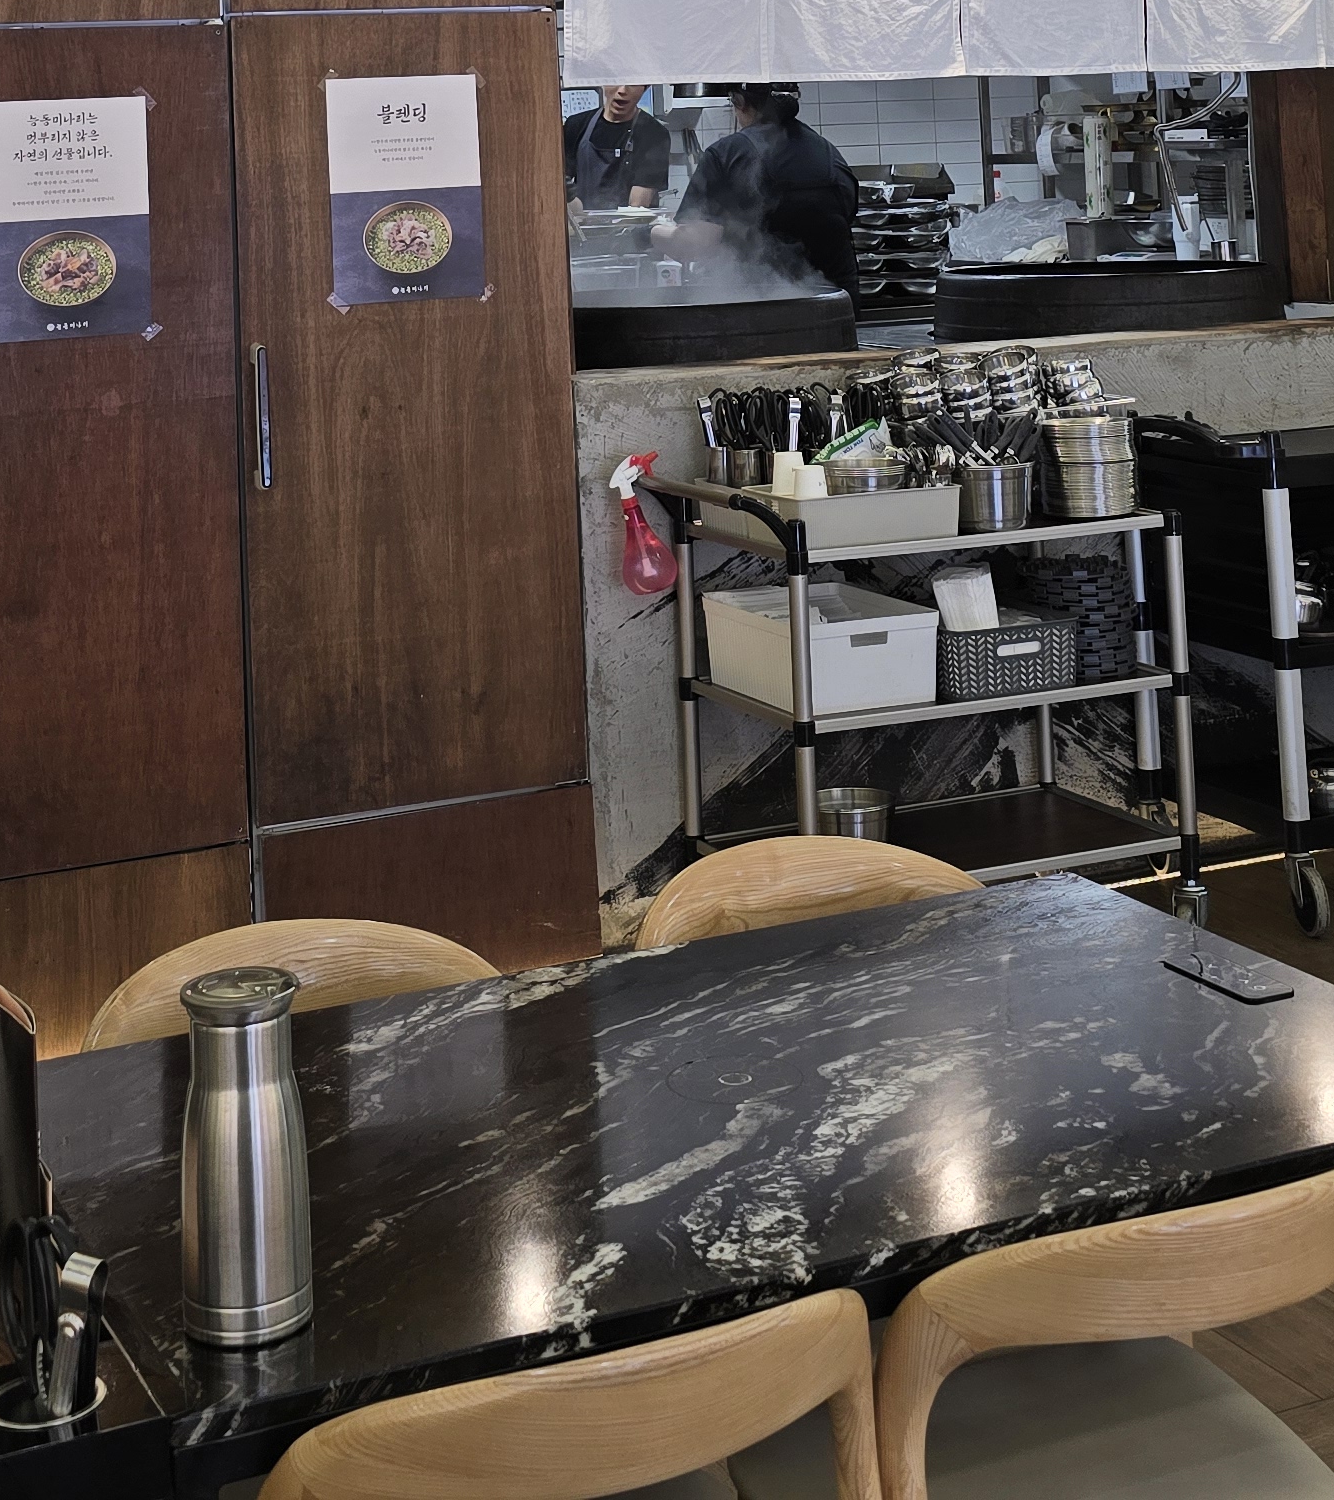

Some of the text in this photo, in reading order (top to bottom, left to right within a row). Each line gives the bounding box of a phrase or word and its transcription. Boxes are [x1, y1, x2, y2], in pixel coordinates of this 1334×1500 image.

[27, 112, 98, 127] 능동미나리는
[376, 103, 428, 125] 블렌딩
[26, 129, 100, 145] 멋부리지 않은
[12, 145, 113, 162] 자연의 선물입니다.
